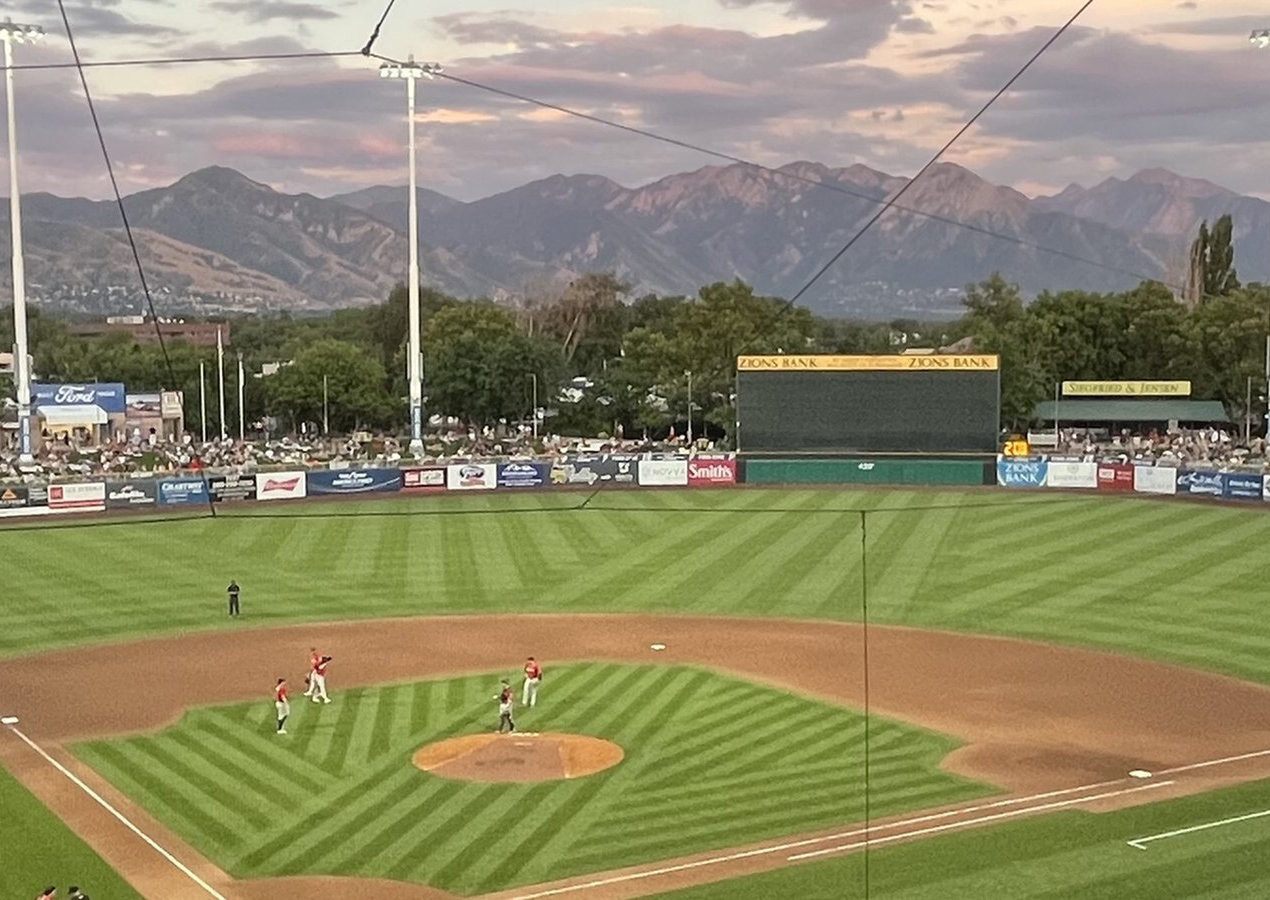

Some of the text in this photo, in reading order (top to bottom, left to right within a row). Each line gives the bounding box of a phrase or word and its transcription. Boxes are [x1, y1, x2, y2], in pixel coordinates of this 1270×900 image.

[739, 358, 778, 368] ZIONS
[782, 358, 817, 368] BANK
[909, 357, 949, 368] ZIONS
[953, 357, 991, 368] BANK
[55, 386, 95, 403] Ford
[688, 464, 733, 479] Smith's
[1005, 463, 1039, 473] ZIONS
[1006, 473, 1038, 482] BANK
